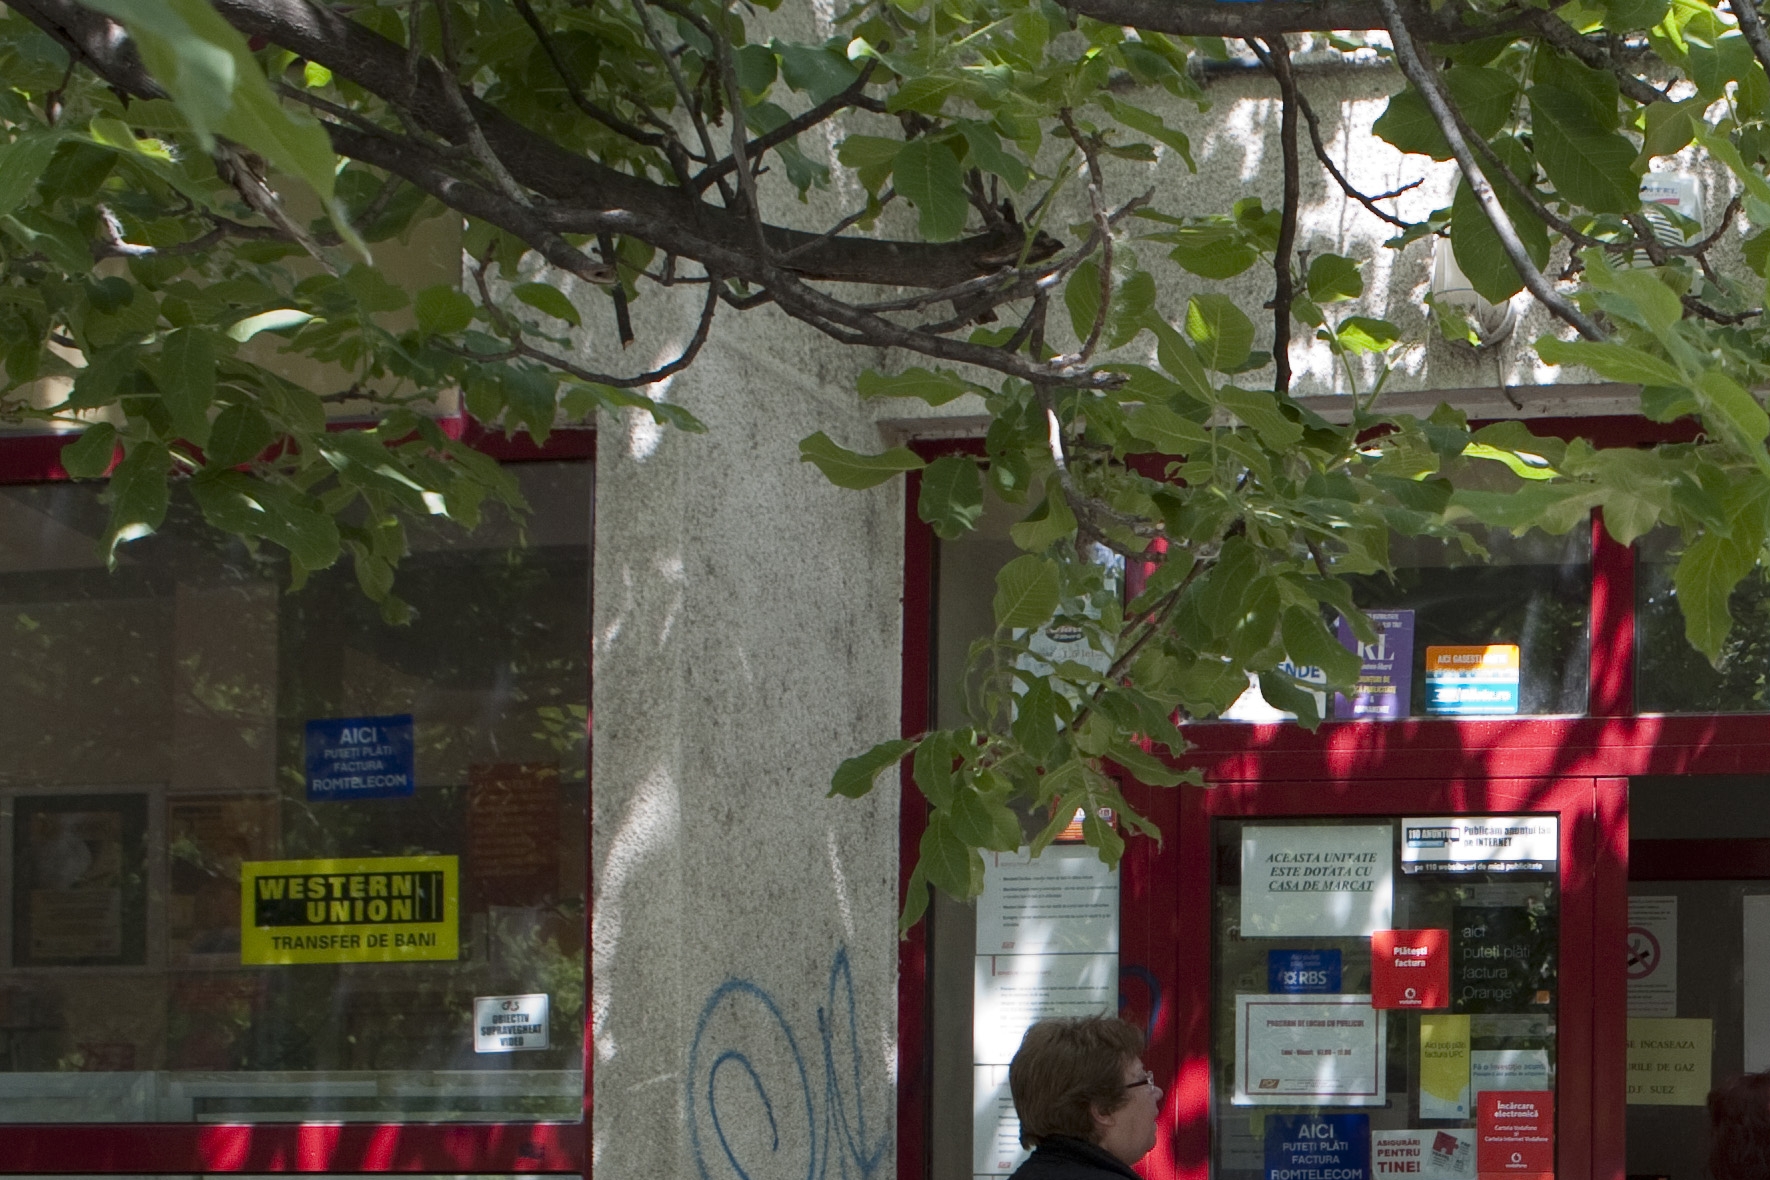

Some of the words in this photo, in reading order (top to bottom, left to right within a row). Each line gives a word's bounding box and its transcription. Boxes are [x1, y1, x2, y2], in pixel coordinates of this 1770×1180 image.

[1278, 662, 1320, 678] NDE
[340, 727, 377, 745] AICI
[333, 760, 384, 772] FACTURA
[312, 774, 407, 792] ROMTELECOM
[1476, 837, 1512, 847] INTERNET
[1265, 852, 1321, 863] ACEASTA
[1324, 852, 1378, 863] UNITATE
[1270, 866, 1300, 877] ESTE
[1303, 866, 1352, 877] DOTATA
[1355, 866, 1373, 877] CU
[258, 874, 413, 900] WESTERN
[1268, 880, 1299, 891] CASA
[1302, 880, 1319, 891] DE
[1322, 880, 1374, 891] MARCAT
[306, 898, 413, 923] UNION
[1463, 926, 1486, 938] aici
[272, 934, 361, 951] TRANSFER
[367, 933, 390, 949] DE
[394, 932, 436, 948] BANI
[1395, 959, 1426, 967] factura
[1298, 970, 1327, 985] RBS
[1463, 966, 1508, 980] factura
[1463, 985, 1513, 1001] Orange
[480, 1024, 542, 1036] SUPRAVEGHEAT
[499, 1037, 524, 1047] VIDEO
[1640, 1040, 1695, 1049] INCASEAZA
[1650, 1086, 1675, 1094] SUEZ
[1297, 1124, 1334, 1139] AICI
[1282, 1142, 1318, 1153] PUTEȚI
[1320, 1140, 1349, 1151] PLĂTI
[1377, 1138, 1421, 1147] ASIGURĂRI
[1377, 1148, 1421, 1157] PENTRU
[1291, 1155, 1340, 1164] FACTURA
[1377, 1161, 1421, 1173] TINE!
[1271, 1169, 1363, 1180] ROMTELECOM
